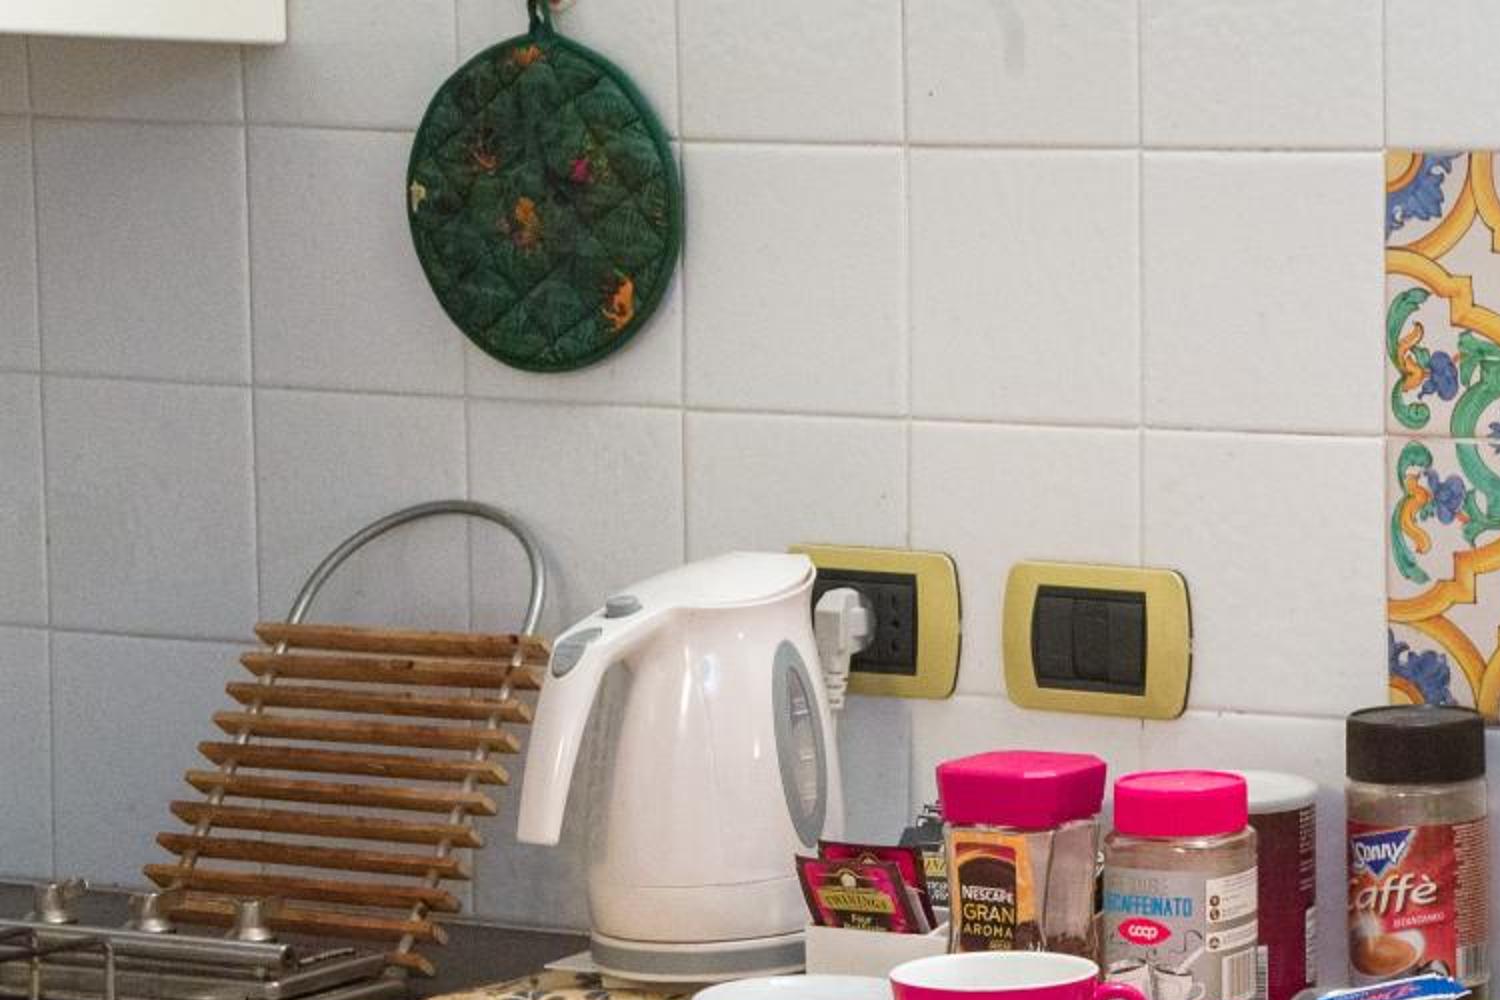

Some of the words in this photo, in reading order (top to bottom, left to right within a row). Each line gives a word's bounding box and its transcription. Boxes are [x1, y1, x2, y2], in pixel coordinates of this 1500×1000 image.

[963, 903, 1015, 923] GRAN
[963, 924, 1013, 938] AROMA
[1128, 924, 1158, 940] coop
